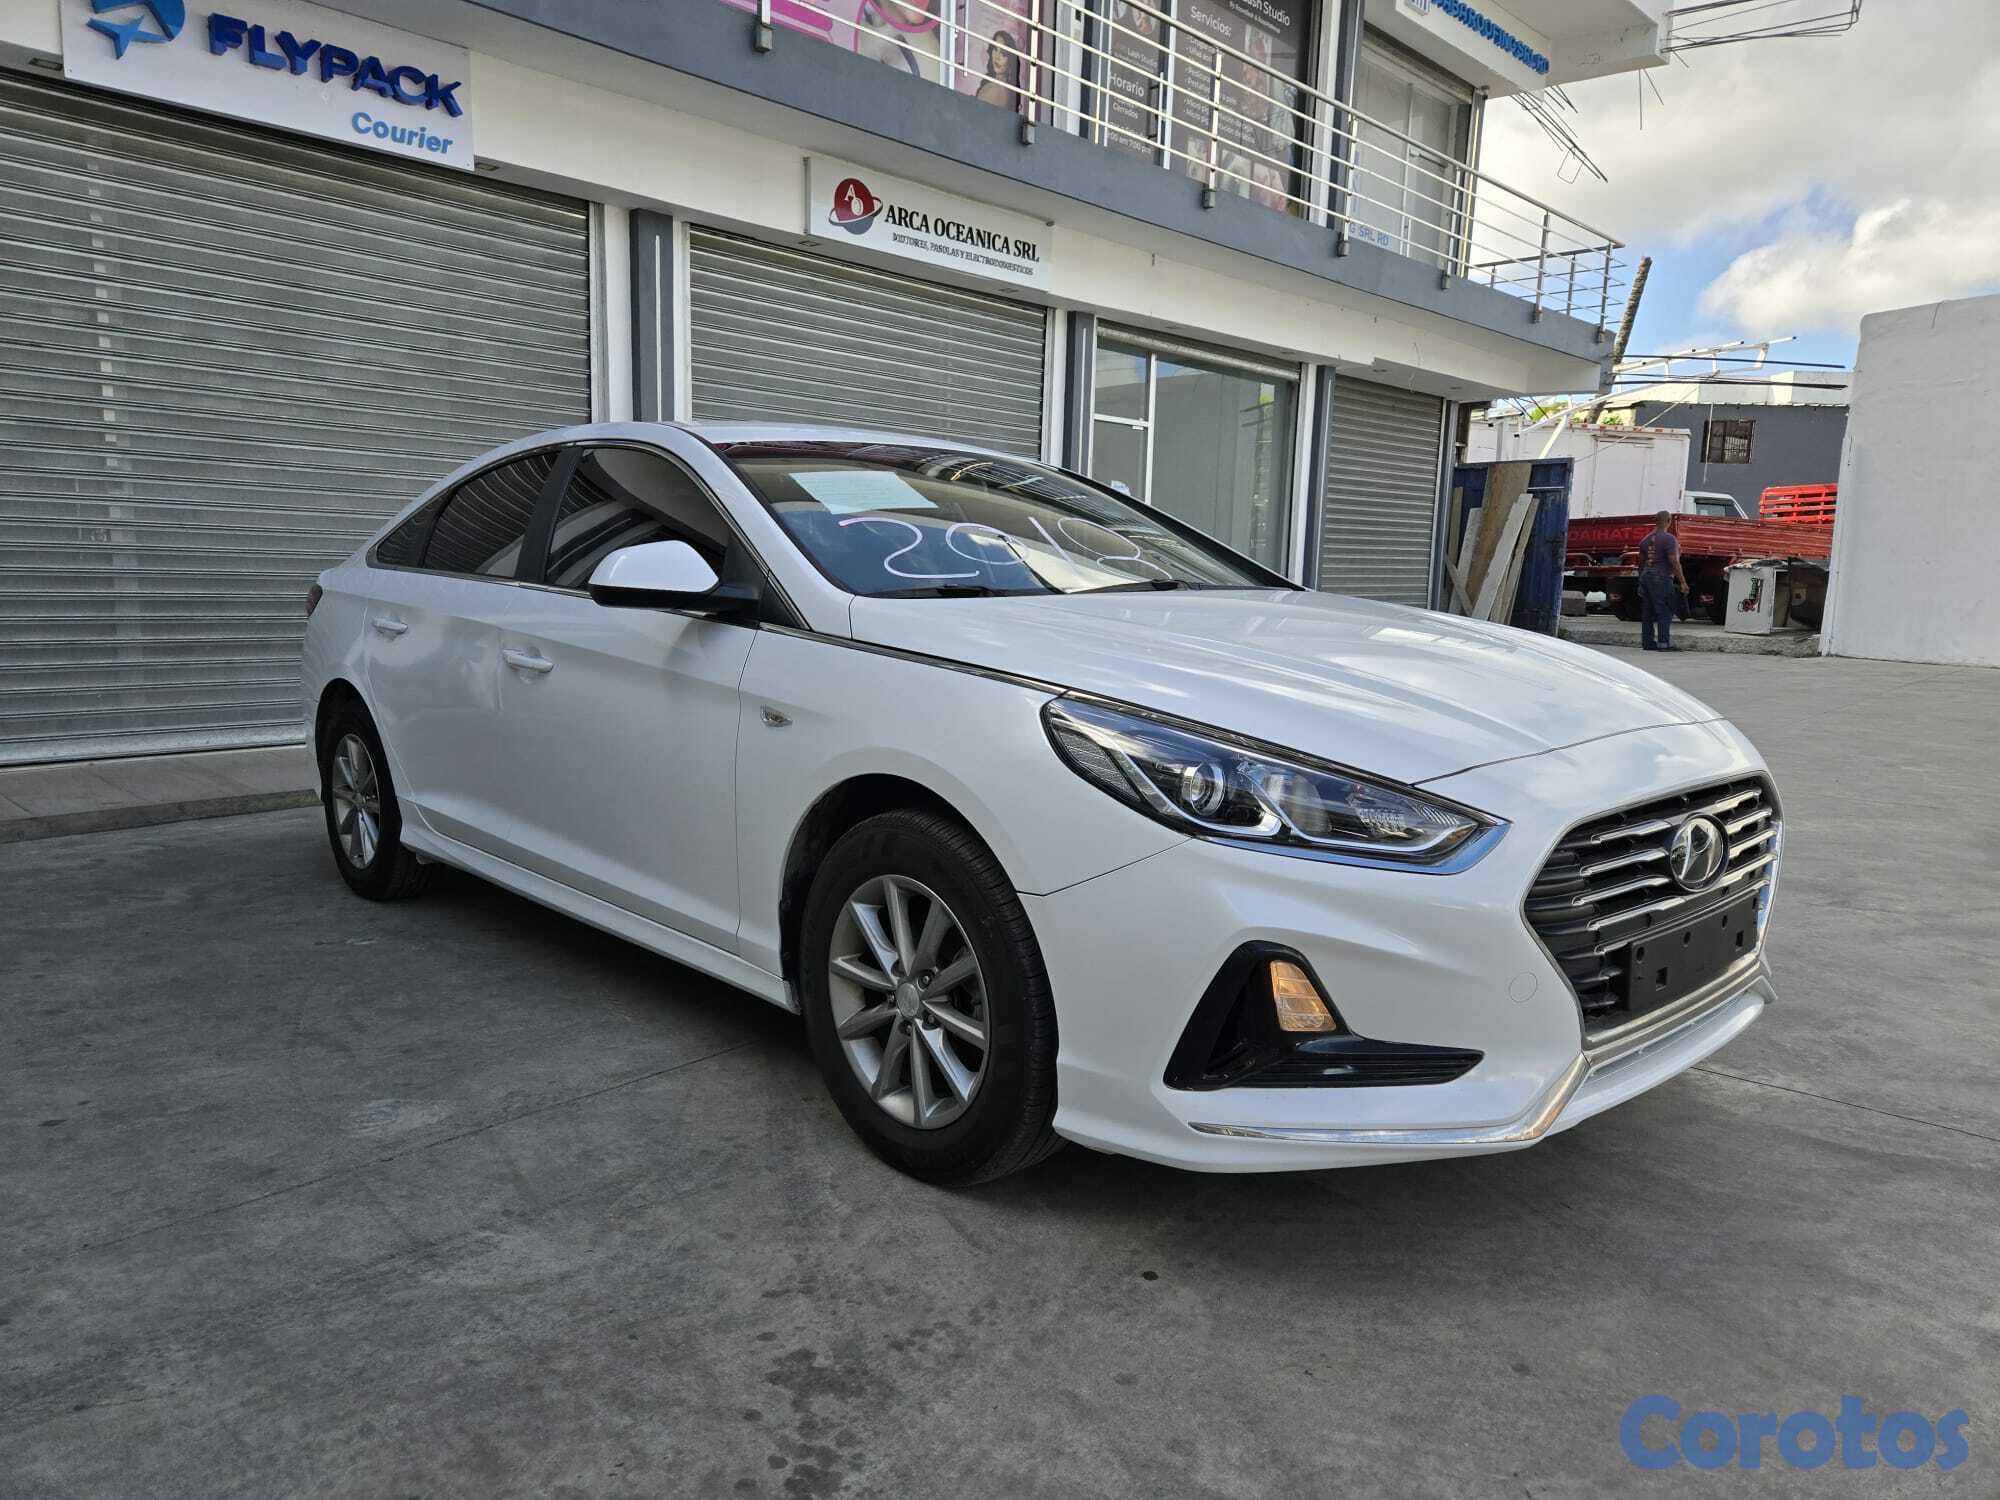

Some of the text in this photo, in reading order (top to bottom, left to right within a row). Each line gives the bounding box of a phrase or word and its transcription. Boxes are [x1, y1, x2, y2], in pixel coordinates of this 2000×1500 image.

[1190, 6, 1232, 37] Servicios:
[1263, 1, 1290, 26] Studio
[208, 13, 463, 117] FLYPACK
[1109, 73, 1145, 97] Horario
[351, 112, 453, 154] Courier
[884, 204, 1040, 263] ARCA OCEANICA SRL
[838, 515, 1173, 582] 2018
[1568, 526, 1657, 542] DAIHATS
